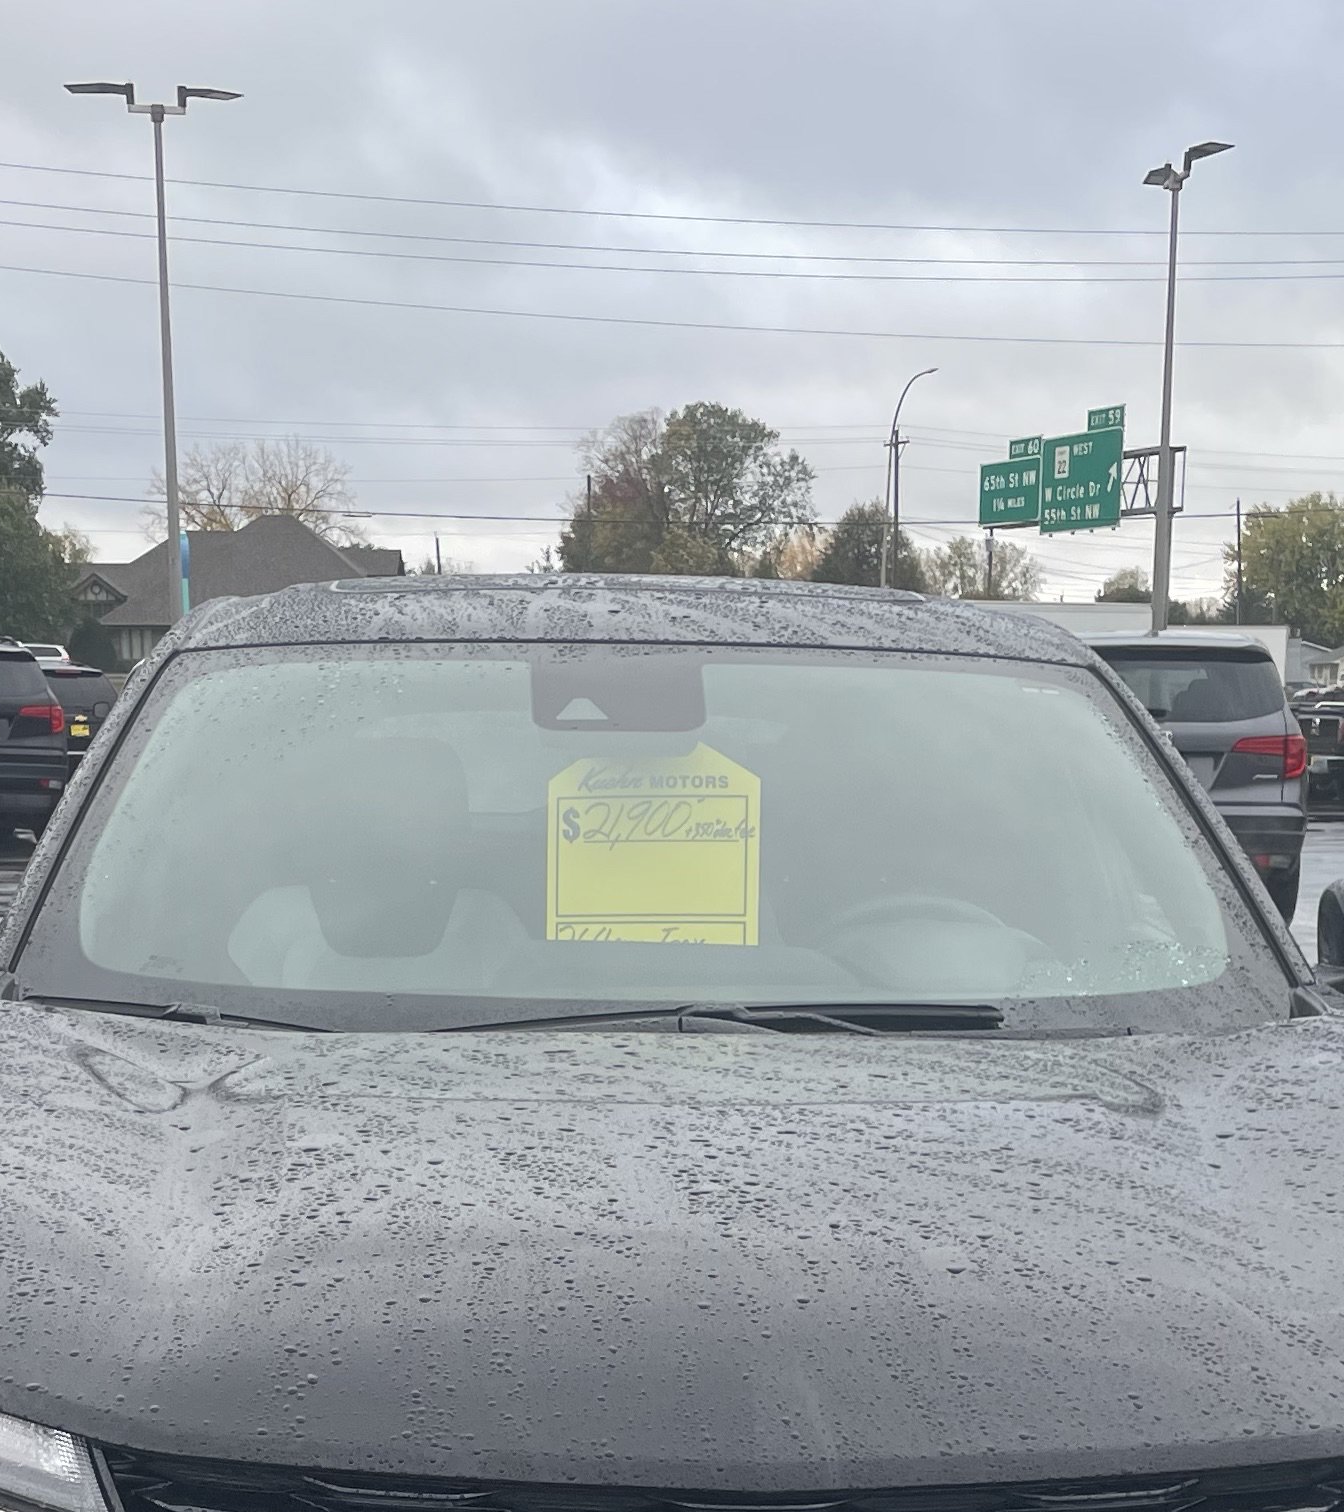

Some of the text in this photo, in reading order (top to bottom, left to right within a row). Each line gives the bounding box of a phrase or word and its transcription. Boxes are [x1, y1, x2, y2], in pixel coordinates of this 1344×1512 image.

[1090, 409, 1121, 426] EXIT 59
[1011, 439, 1040, 455] EXIT 60
[1057, 442, 1093, 474] 22 WEST
[984, 470, 1036, 491] 65th St NW
[1044, 482, 1101, 502] W Circle Dr
[1044, 504, 1100, 524] 55th St NW
[577, 766, 729, 793] Kuehn MOTORS
